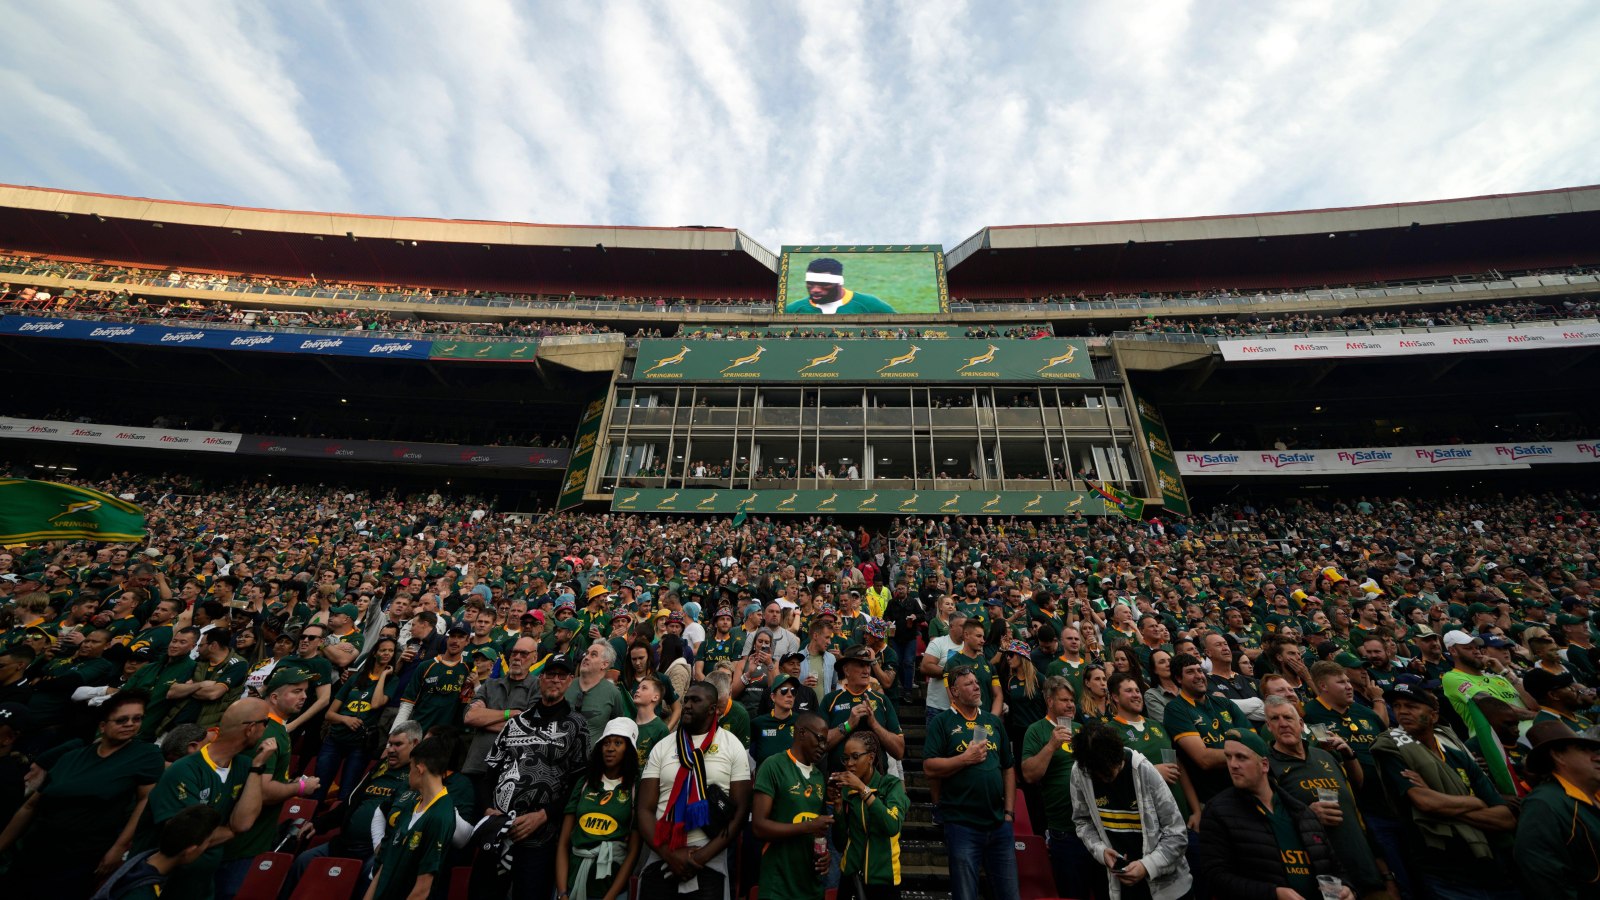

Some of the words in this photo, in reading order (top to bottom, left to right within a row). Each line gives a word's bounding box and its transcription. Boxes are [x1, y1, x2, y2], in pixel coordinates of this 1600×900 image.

[778, 252, 789, 314] SPRINGBOKS
[936, 251, 948, 313] SPRINGBOKS
[19, 322, 64, 332] Energade
[90, 327, 135, 338] Energade
[161, 332, 204, 342] Energade
[231, 336, 274, 346] Energade
[1507, 335, 1545, 343] AfriSam
[301, 339, 343, 350] Energade
[370, 343, 412, 353] Energade
[27, 426, 58, 434] AfriSam
[71, 428, 102, 437] AfriSam
[115, 432, 146, 440] AfriSam
[160, 435, 189, 443] AfriSam
[203, 437, 232, 445] AfriSam
[1337, 451, 1393, 465] FlySafair
[1416, 449, 1472, 463] FlySafair
[1495, 446, 1552, 460] FlySafair
[1186, 454, 1239, 467] FlySafair
[1261, 453, 1315, 468] FlySafair
[1350, 734, 1374, 743] ABS
[1299, 778, 1341, 790] CASTLE
[365, 785, 393, 797] CASTL
[585, 816, 612, 831] MTN
